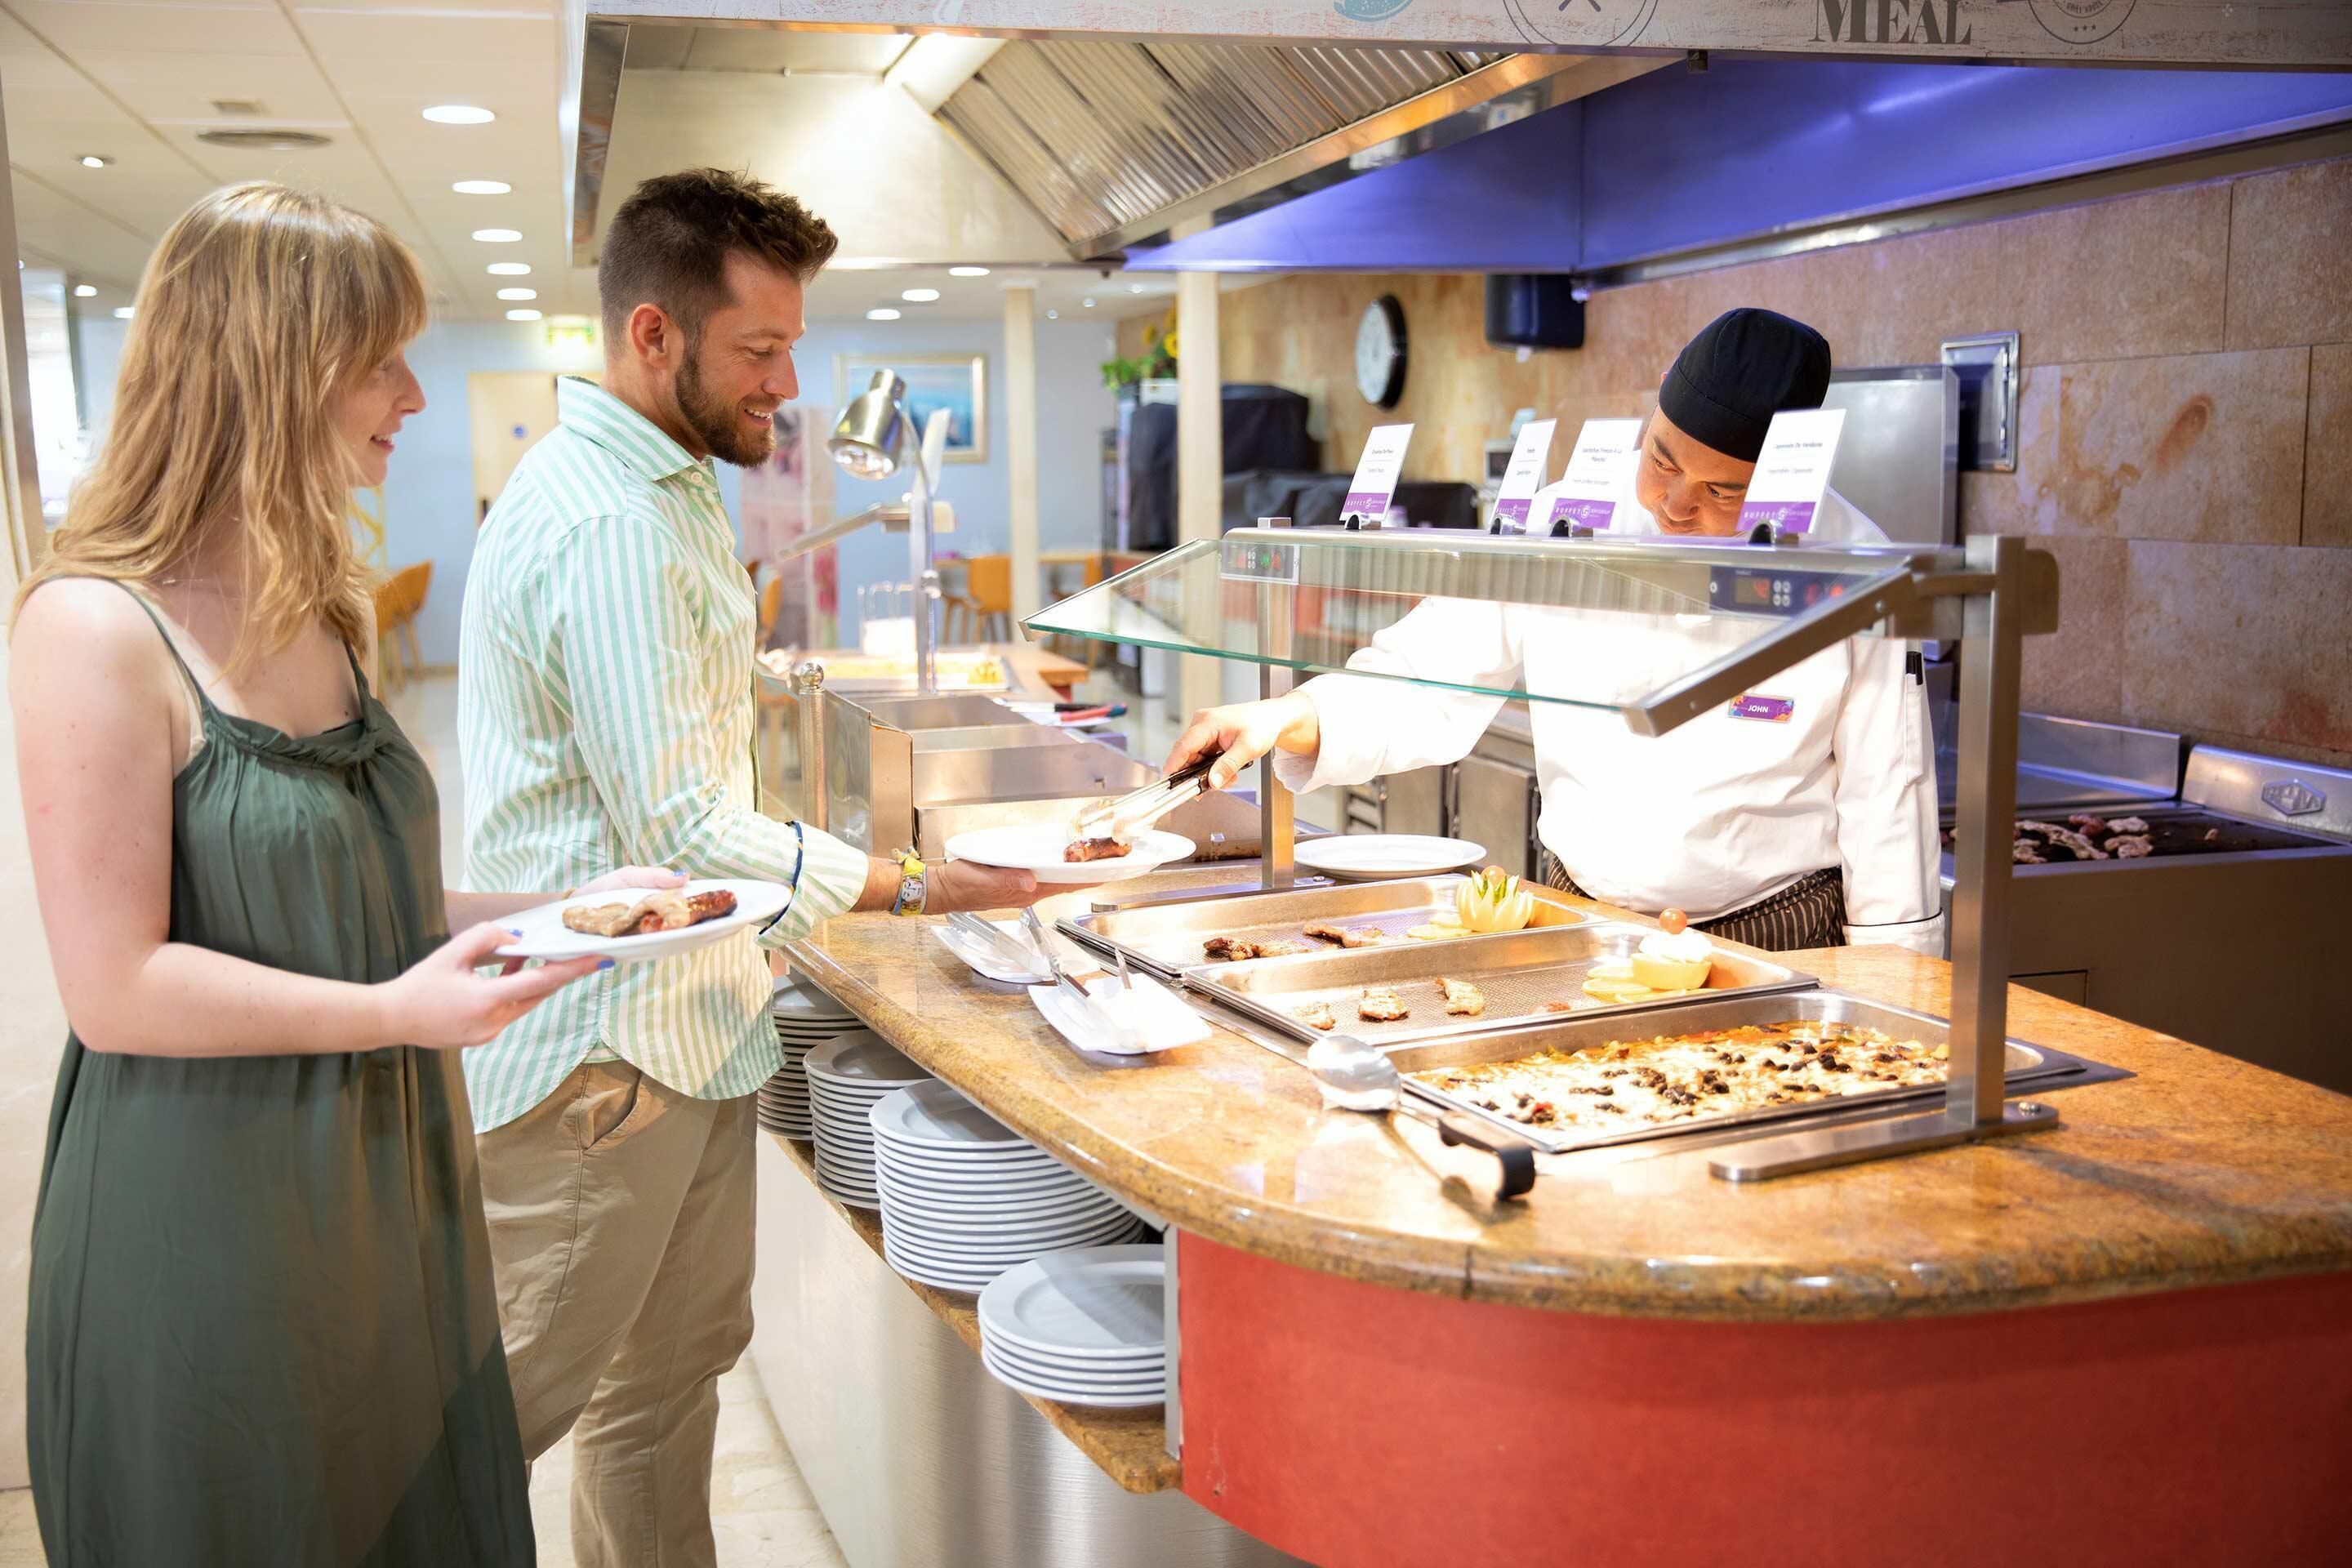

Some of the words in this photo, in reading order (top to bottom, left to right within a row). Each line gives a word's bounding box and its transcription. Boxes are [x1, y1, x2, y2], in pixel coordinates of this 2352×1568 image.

[1808, 0, 1971, 45] MEAL
[1744, 510, 1775, 519] BUFFET
[1748, 705, 1769, 713] JOHN
